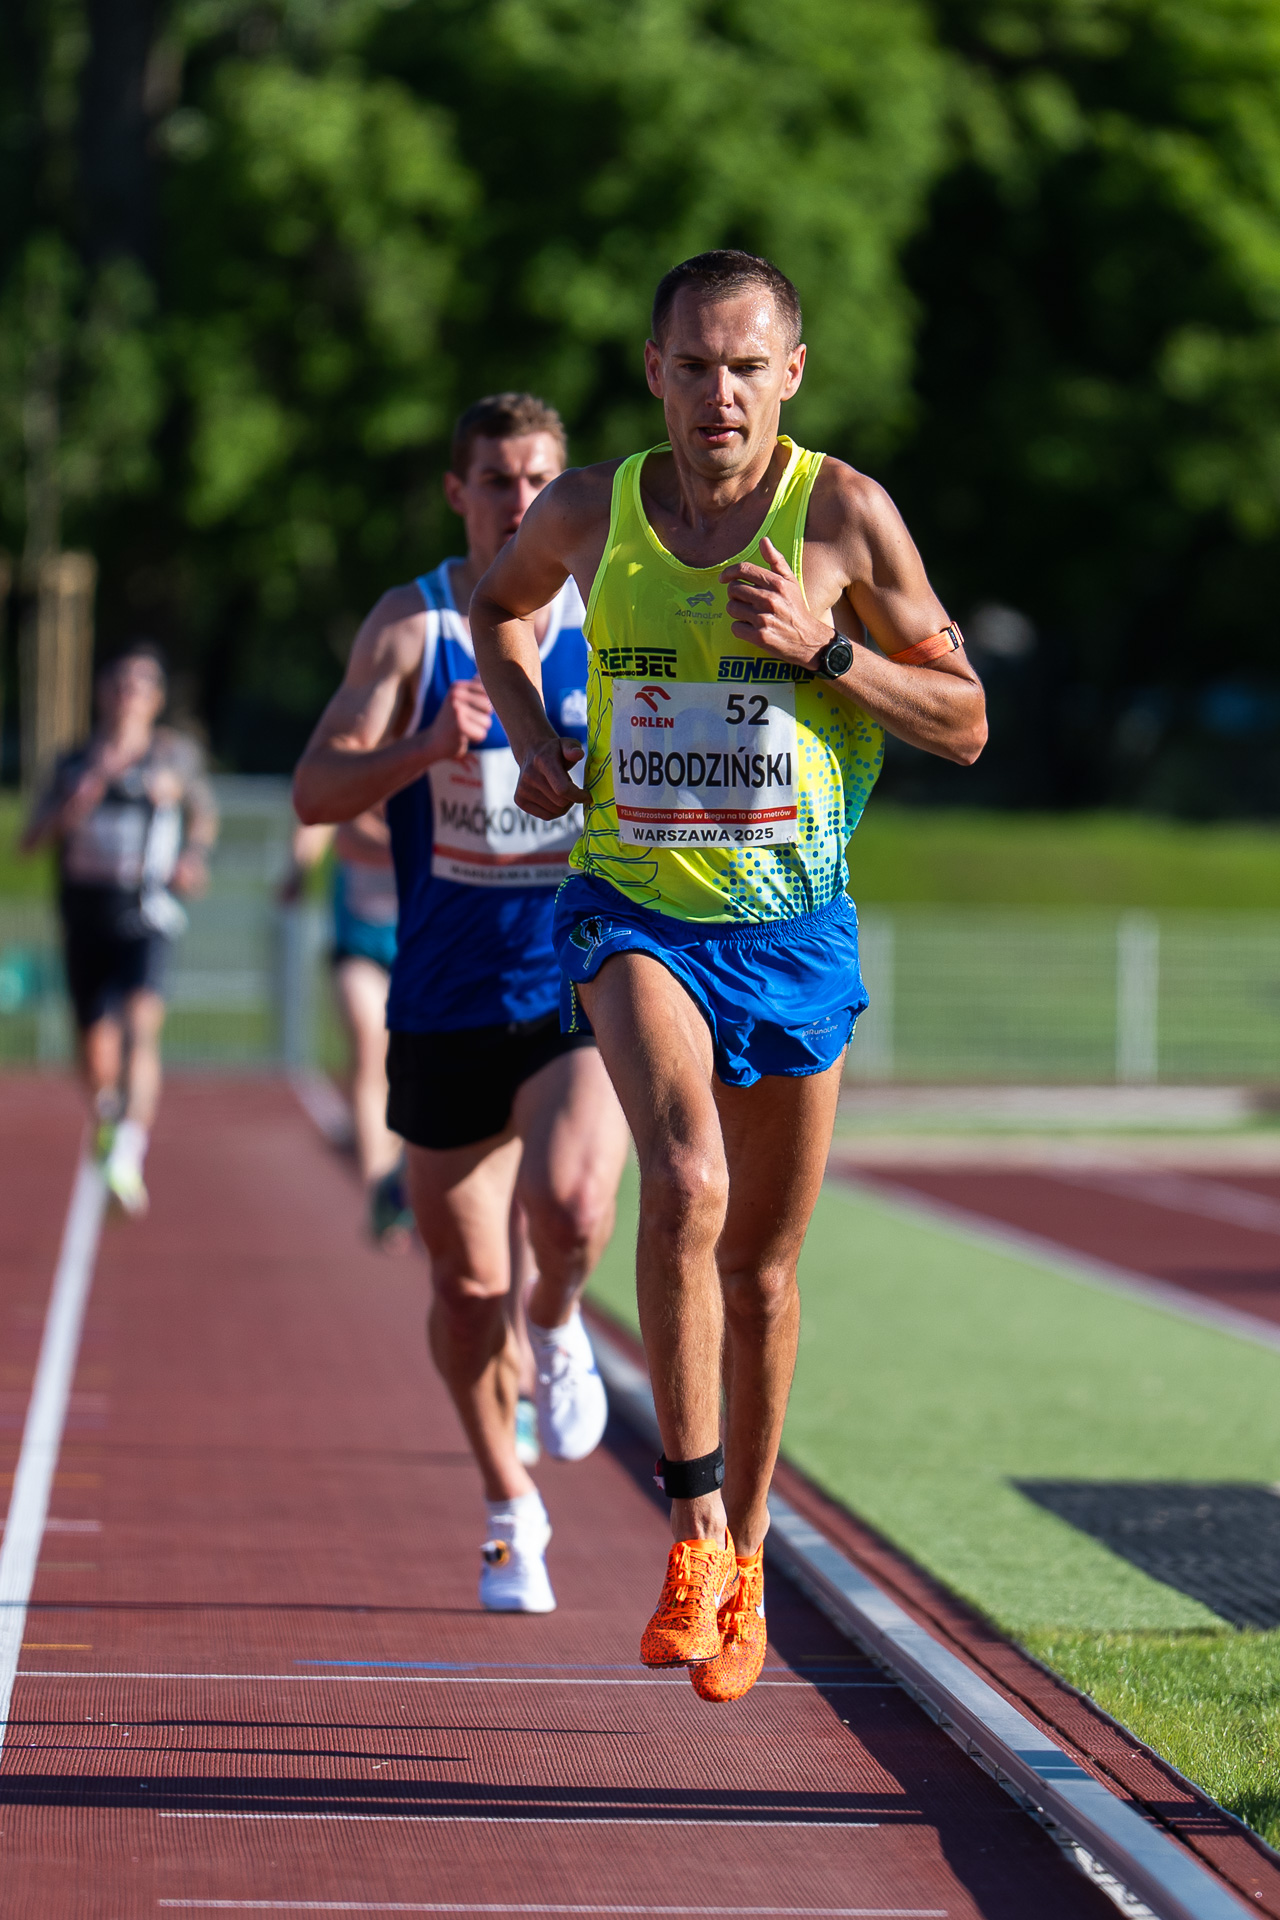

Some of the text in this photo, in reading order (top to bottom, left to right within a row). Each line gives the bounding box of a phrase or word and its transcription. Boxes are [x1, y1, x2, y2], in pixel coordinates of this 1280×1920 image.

[725, 693, 770, 726] 52
[630, 715, 675, 729] ORLEN
[618, 746, 792, 788] ŁOBODZIŃSKI
[633, 810, 672, 820] Mistrzostwa
[673, 812, 695, 820] Polski
[704, 812, 726, 822] Biegu
[747, 812, 762, 820] 000
[763, 809, 791, 819] metrów
[632, 827, 774, 842] WARSZAWA 2025
